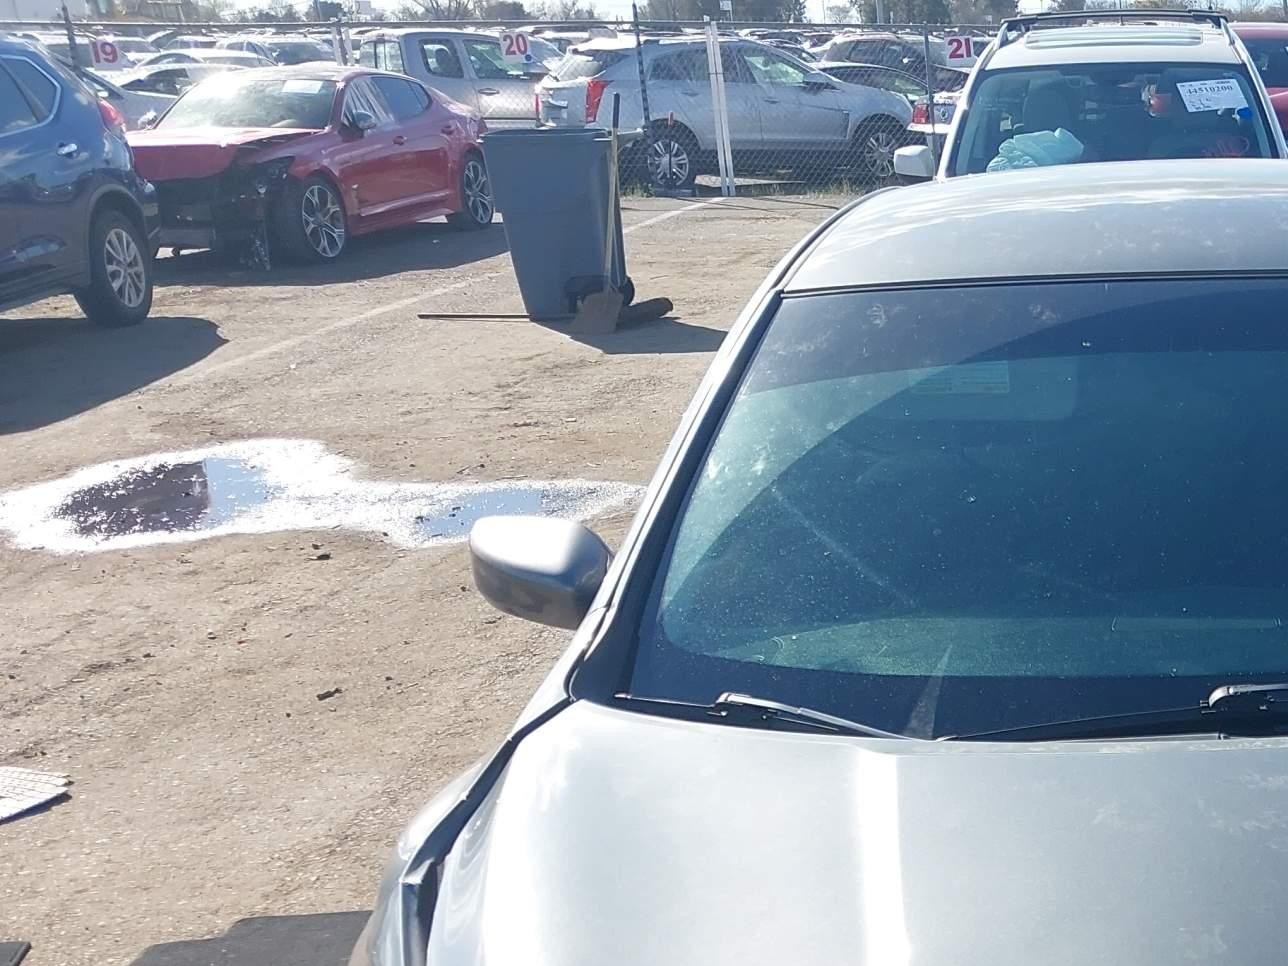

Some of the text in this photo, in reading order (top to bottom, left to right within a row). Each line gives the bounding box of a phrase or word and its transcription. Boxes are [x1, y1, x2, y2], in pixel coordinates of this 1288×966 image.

[91, 41, 118, 64] 19
[502, 33, 528, 55] 20
[947, 37, 972, 59] 21
